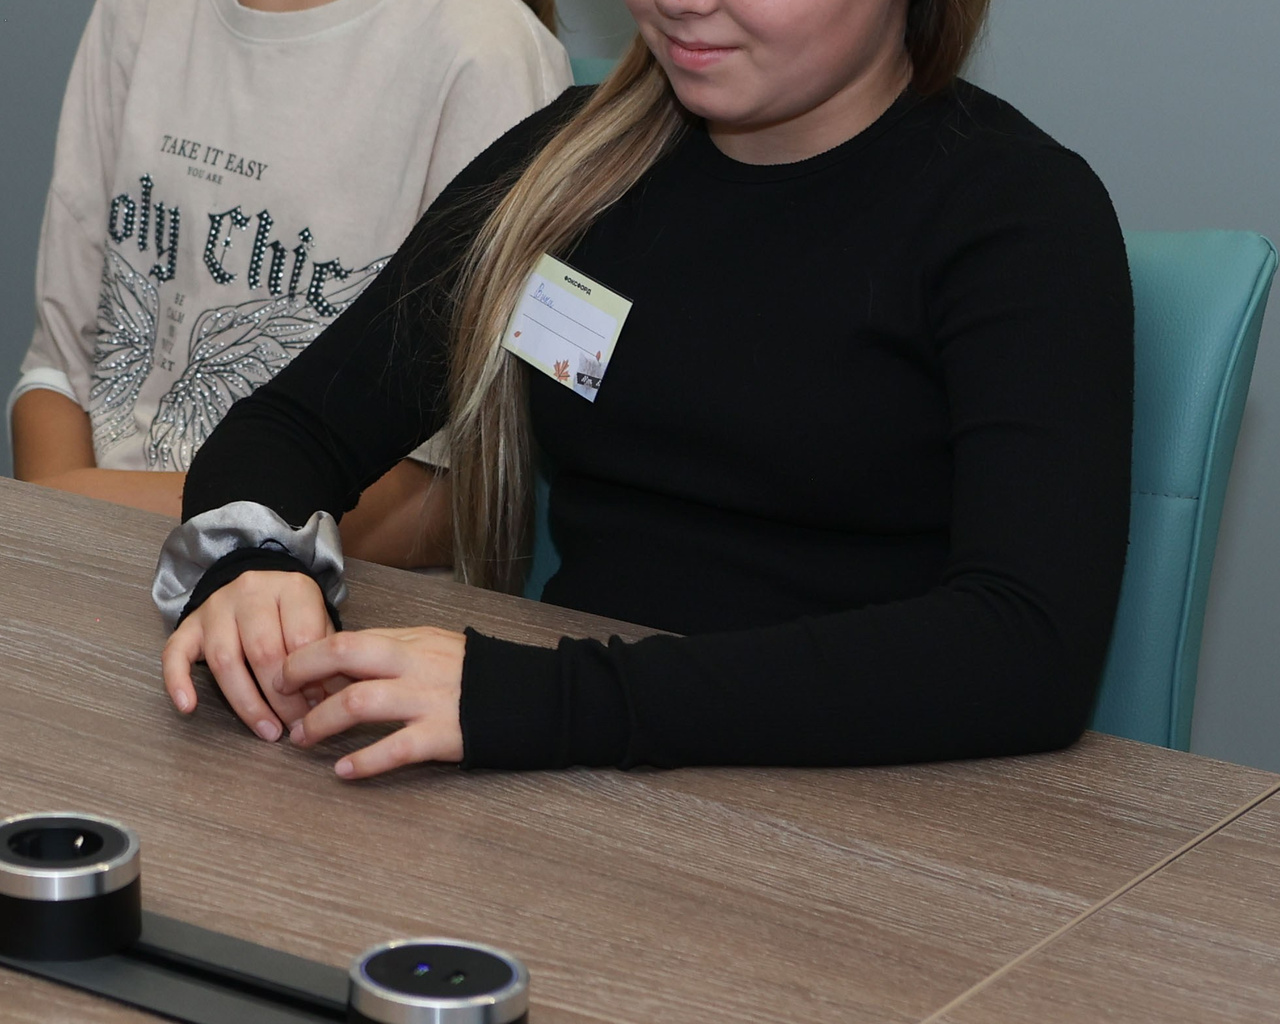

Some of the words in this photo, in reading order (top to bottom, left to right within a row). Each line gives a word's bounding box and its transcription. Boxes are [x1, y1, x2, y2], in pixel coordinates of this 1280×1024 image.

[160, 135, 201, 160] TAKE
[203, 146, 223, 166] IT
[224, 153, 268, 181] EASY
[187, 166, 206, 179] YOU
[205, 172, 223, 185] ARE
[203, 205, 354, 318] Chic
